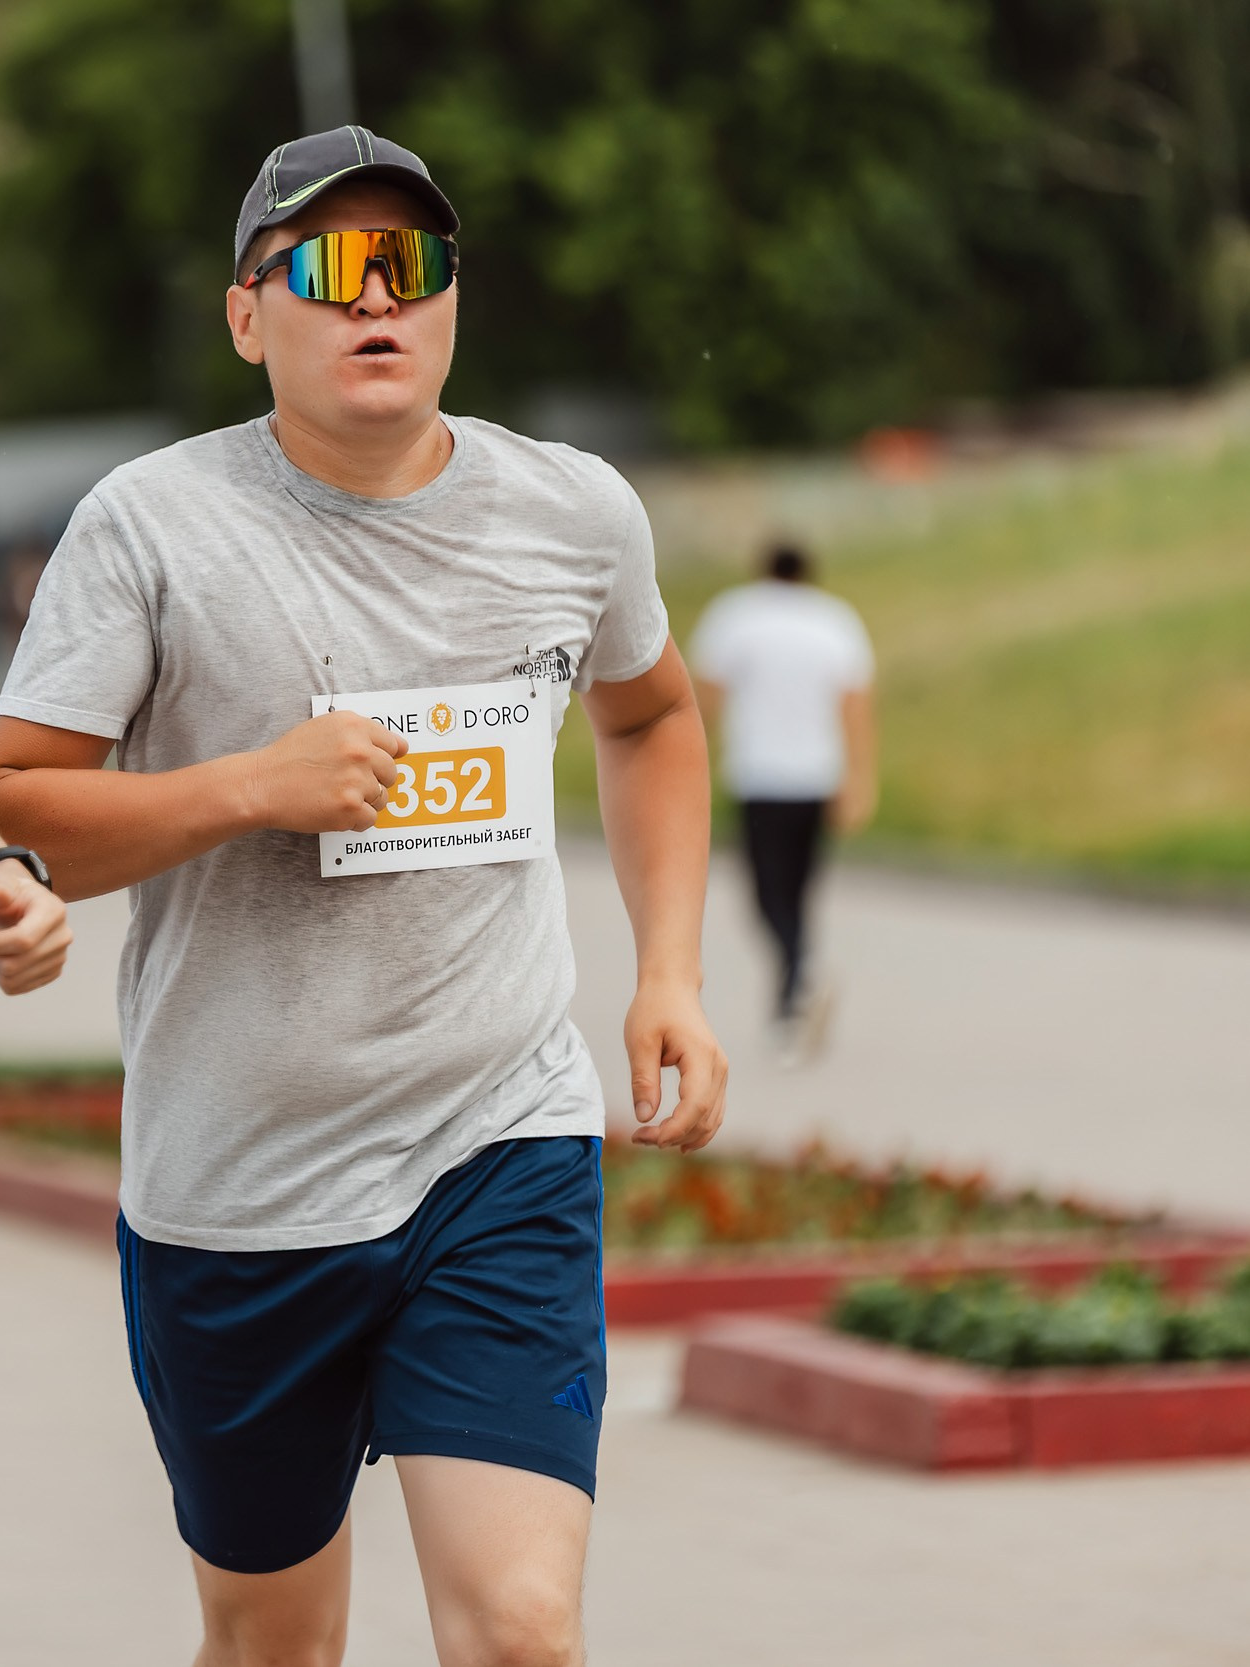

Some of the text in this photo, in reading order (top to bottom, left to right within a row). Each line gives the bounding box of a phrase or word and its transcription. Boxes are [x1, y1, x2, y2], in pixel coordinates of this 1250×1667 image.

[536, 648, 555, 661] THE
[513, 660, 556, 676] NORTH
[463, 704, 529, 729] D'ORO
[385, 757, 493, 818] 352
[345, 827, 532, 855] БЛАГОТВОРИТЕЛЬНЫЙ ЗАБЕГ
